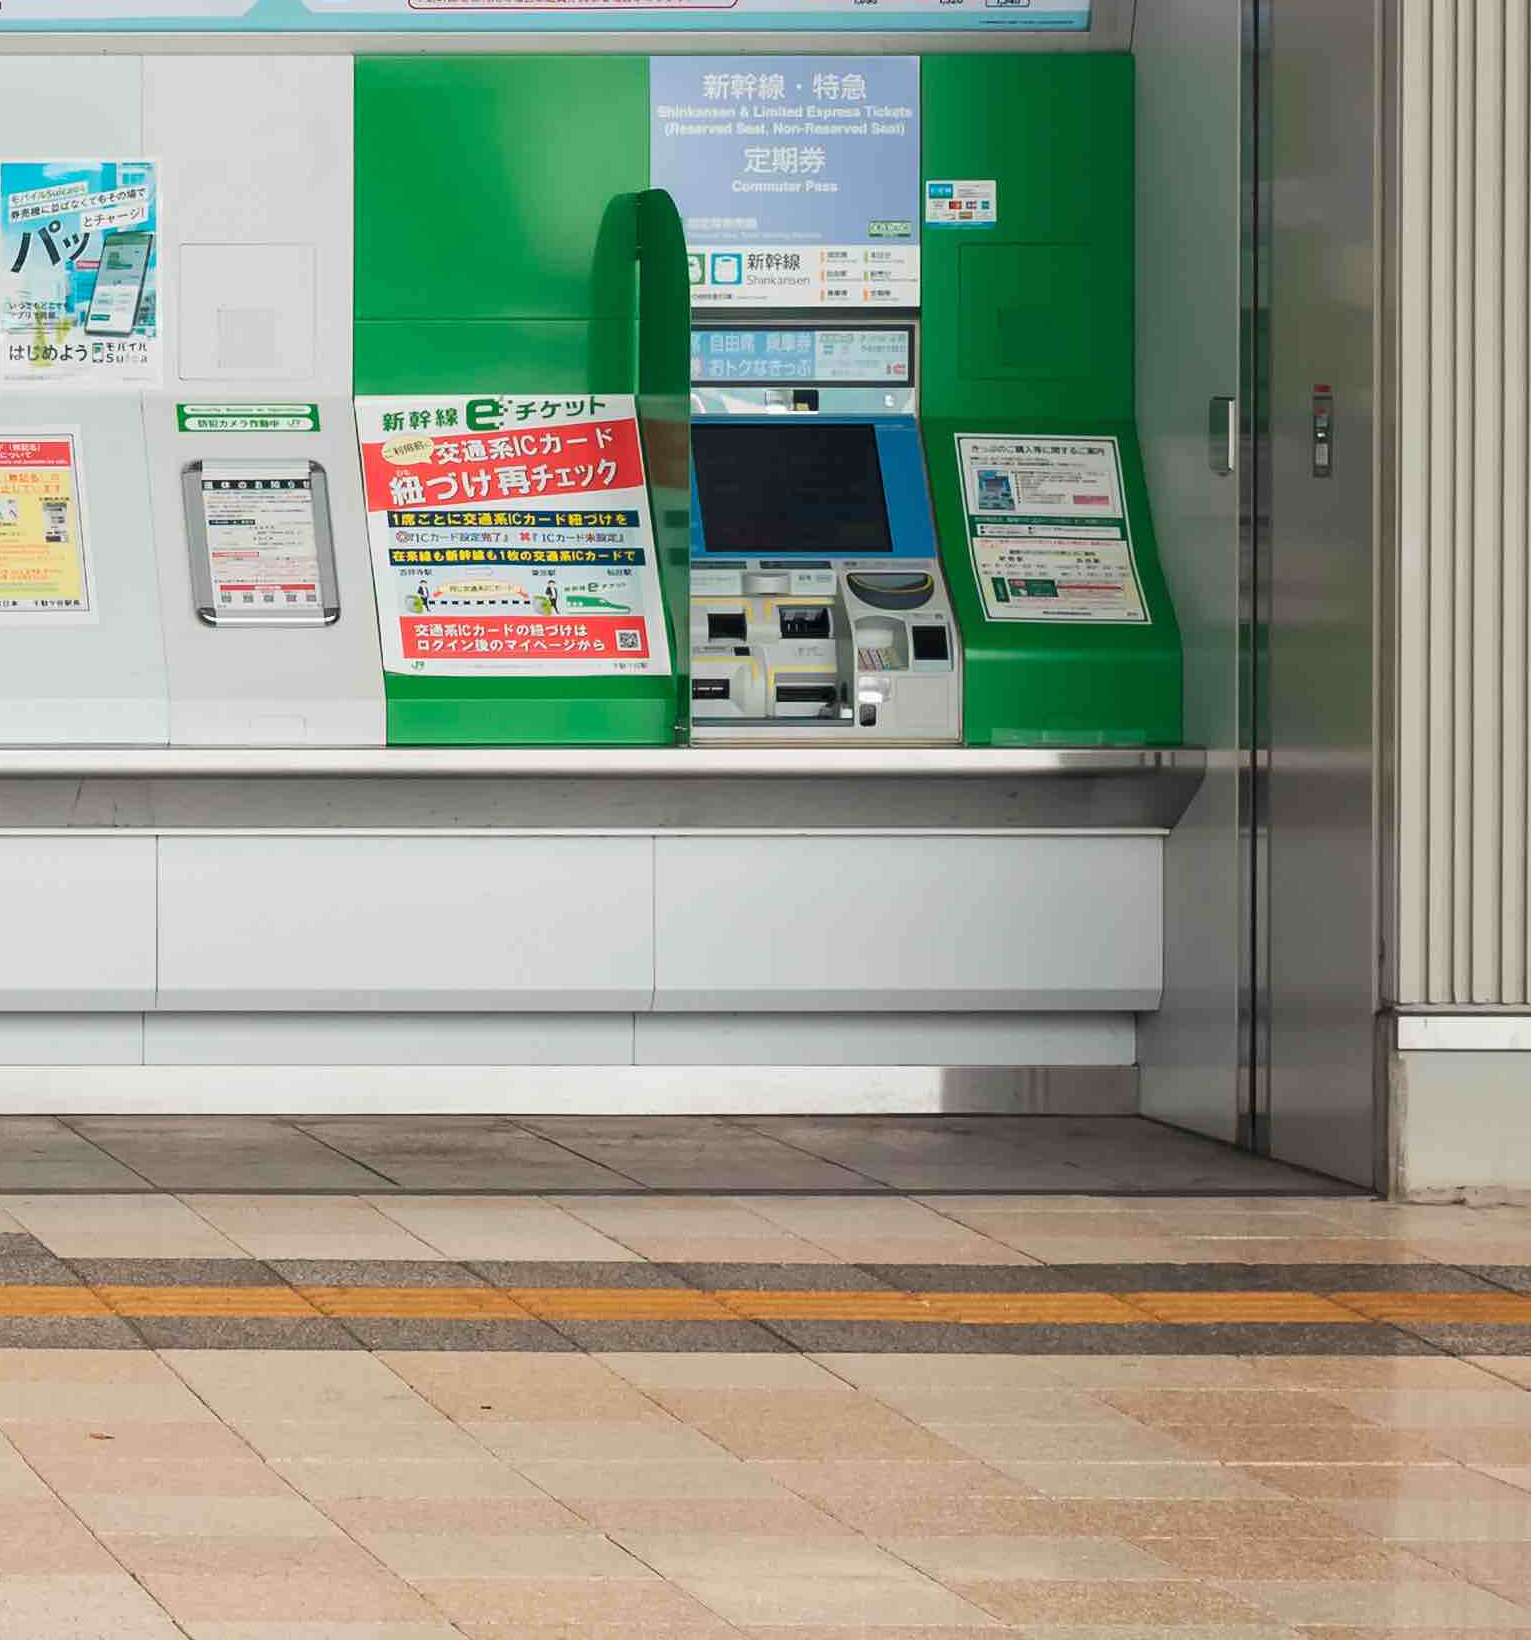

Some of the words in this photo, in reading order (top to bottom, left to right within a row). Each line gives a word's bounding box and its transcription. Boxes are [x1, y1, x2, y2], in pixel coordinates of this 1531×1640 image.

[657, 105, 737, 118] Shinkansen
[753, 105, 803, 119] Limited
[807, 106, 861, 121] Express
[864, 106, 913, 119] Tickets
[665, 122, 732, 136] (Reserved
[773, 122, 868, 136] Non-Reserved
[871, 122, 906, 137] Seat)
[744, 147, 827, 174] 定期券
[732, 180, 801, 192] Commuter
[806, 180, 839, 192] Pass
[747, 252, 801, 272] 新幹線
[747, 274, 811, 286] Shinkansen
[9, 344, 88, 361] はじめよう
[434, 426, 614, 465] 交通系ICカード
[389, 459, 618, 506] 紐づけ再チェック
